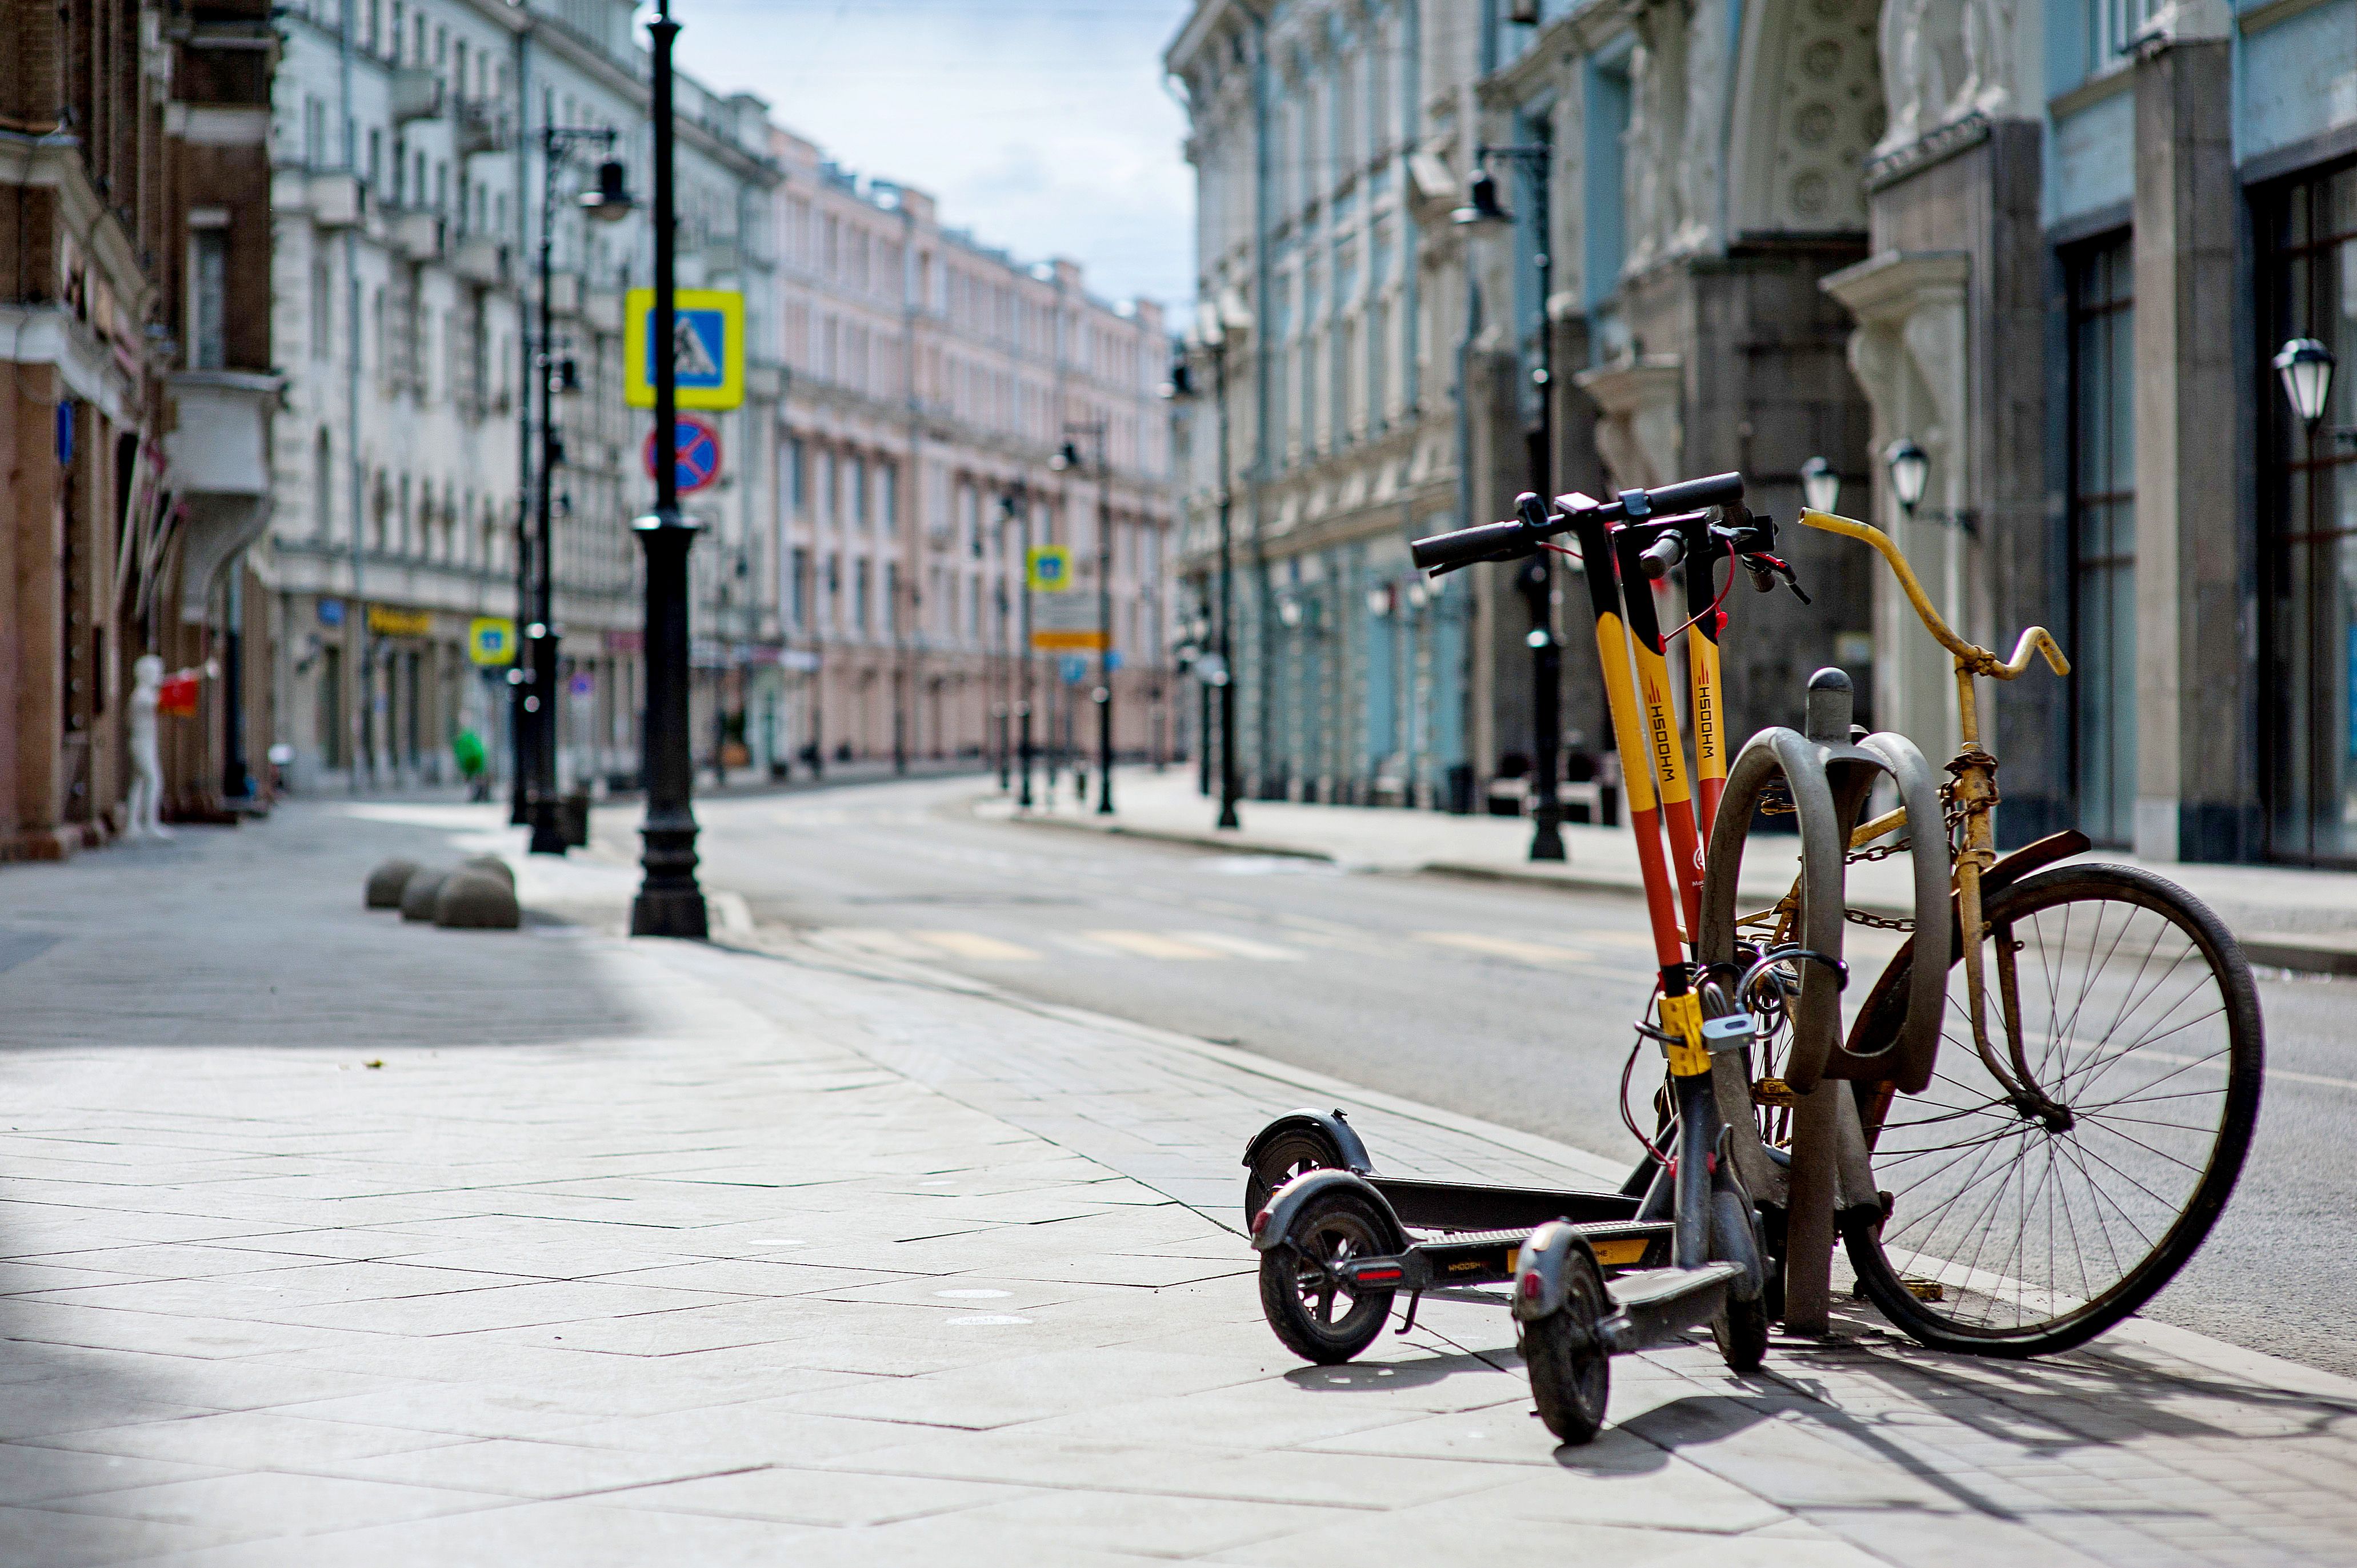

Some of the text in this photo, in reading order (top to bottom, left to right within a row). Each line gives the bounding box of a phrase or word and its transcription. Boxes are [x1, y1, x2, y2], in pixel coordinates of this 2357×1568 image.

[1651, 705, 1675, 782] WHOOSH
[1699, 687, 1714, 759] WHOOSH
[1448, 1261, 1481, 1272] WHOOSH
